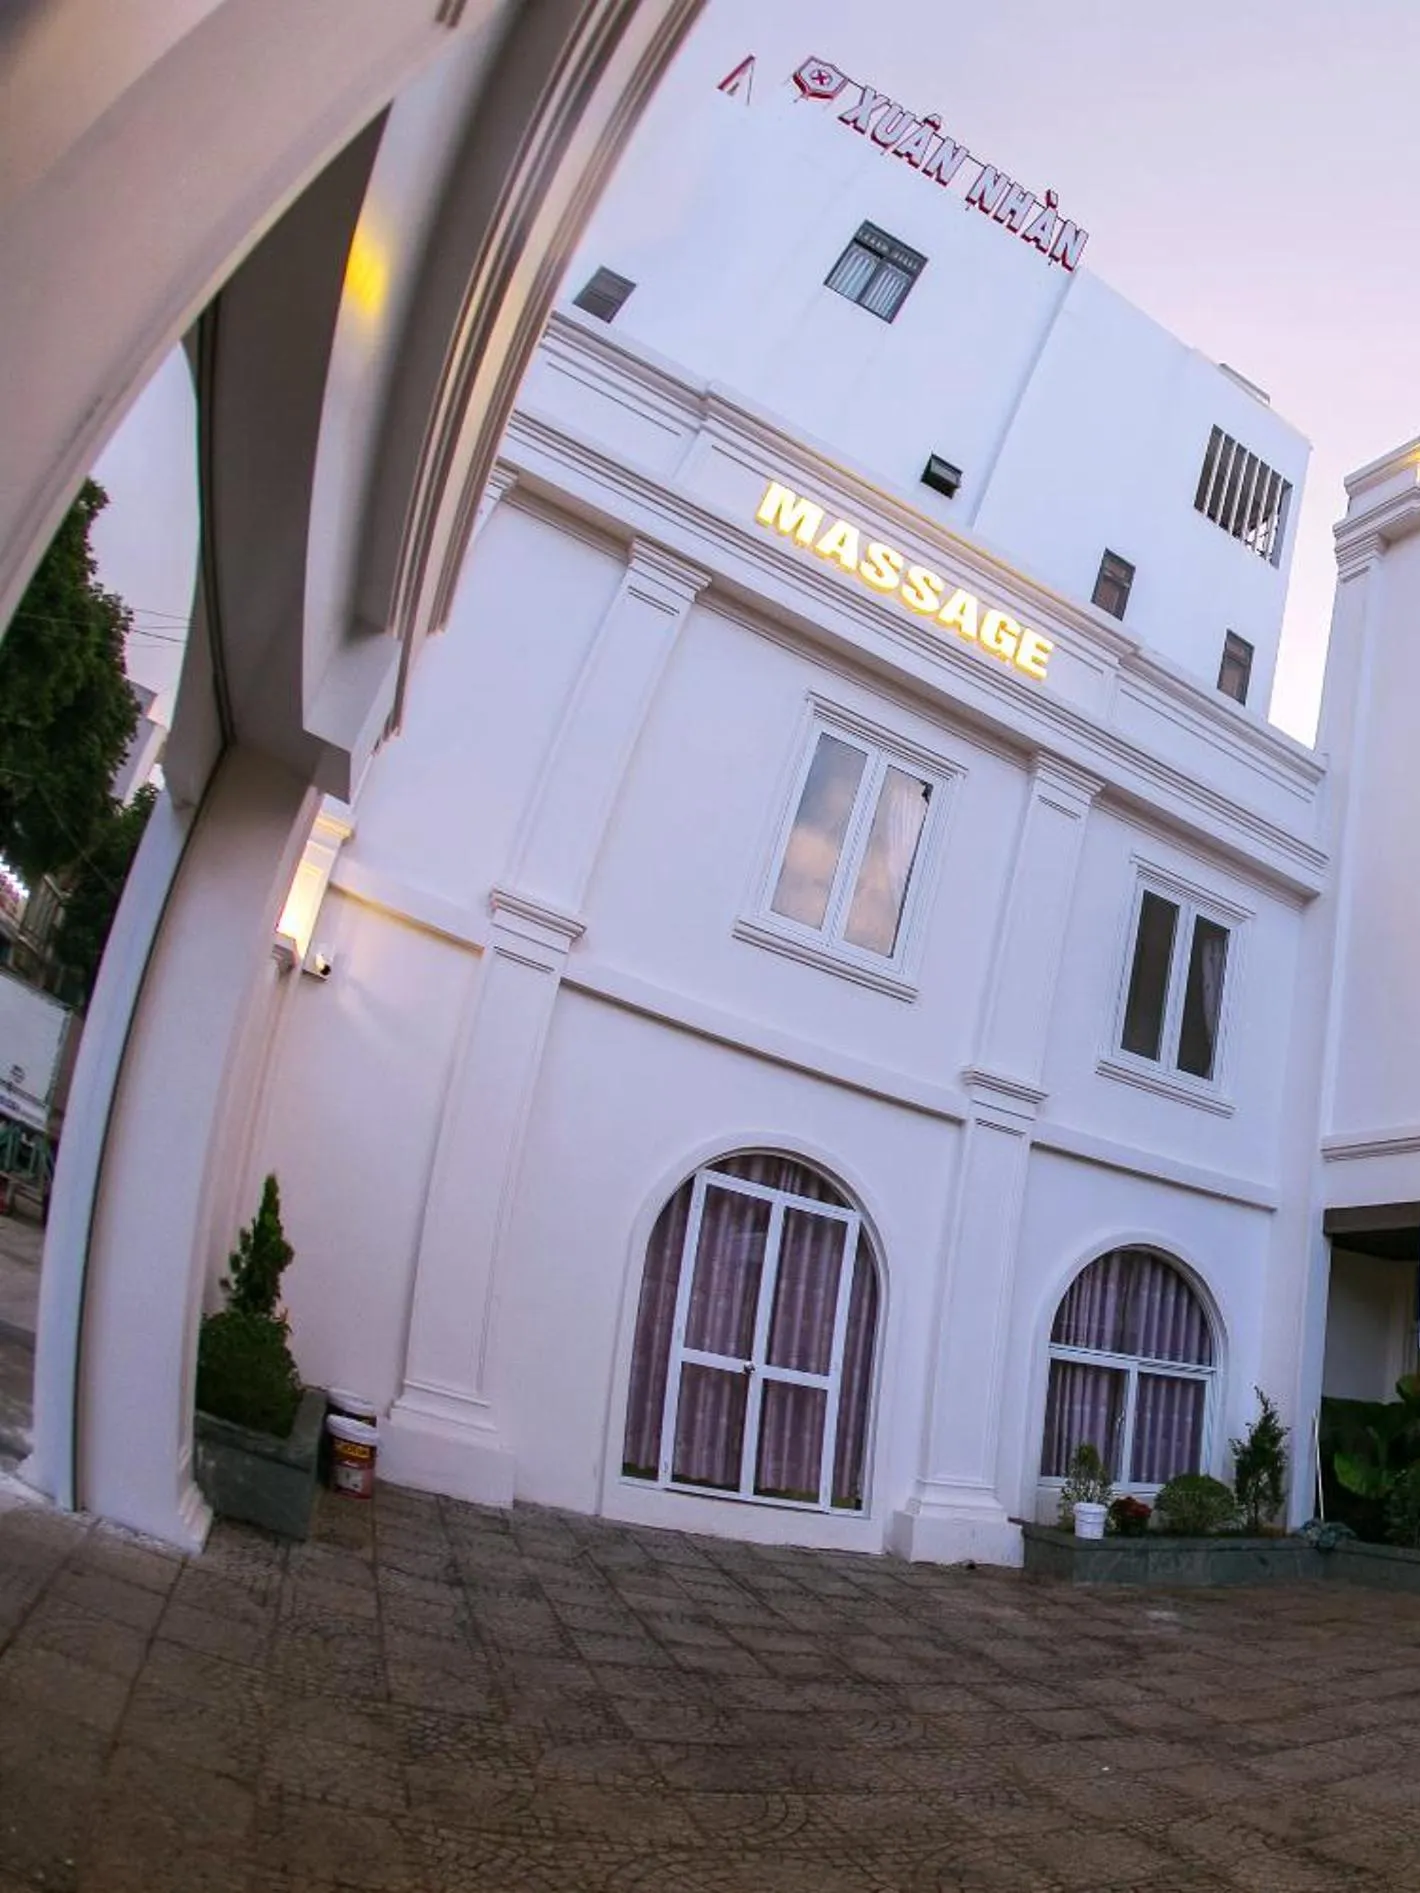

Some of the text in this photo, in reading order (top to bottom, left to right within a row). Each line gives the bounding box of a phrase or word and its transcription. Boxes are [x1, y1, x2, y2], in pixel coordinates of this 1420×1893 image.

[837, 85, 1090, 272] XUÂN NHÀN
[755, 480, 1055, 679] MASSAGE
